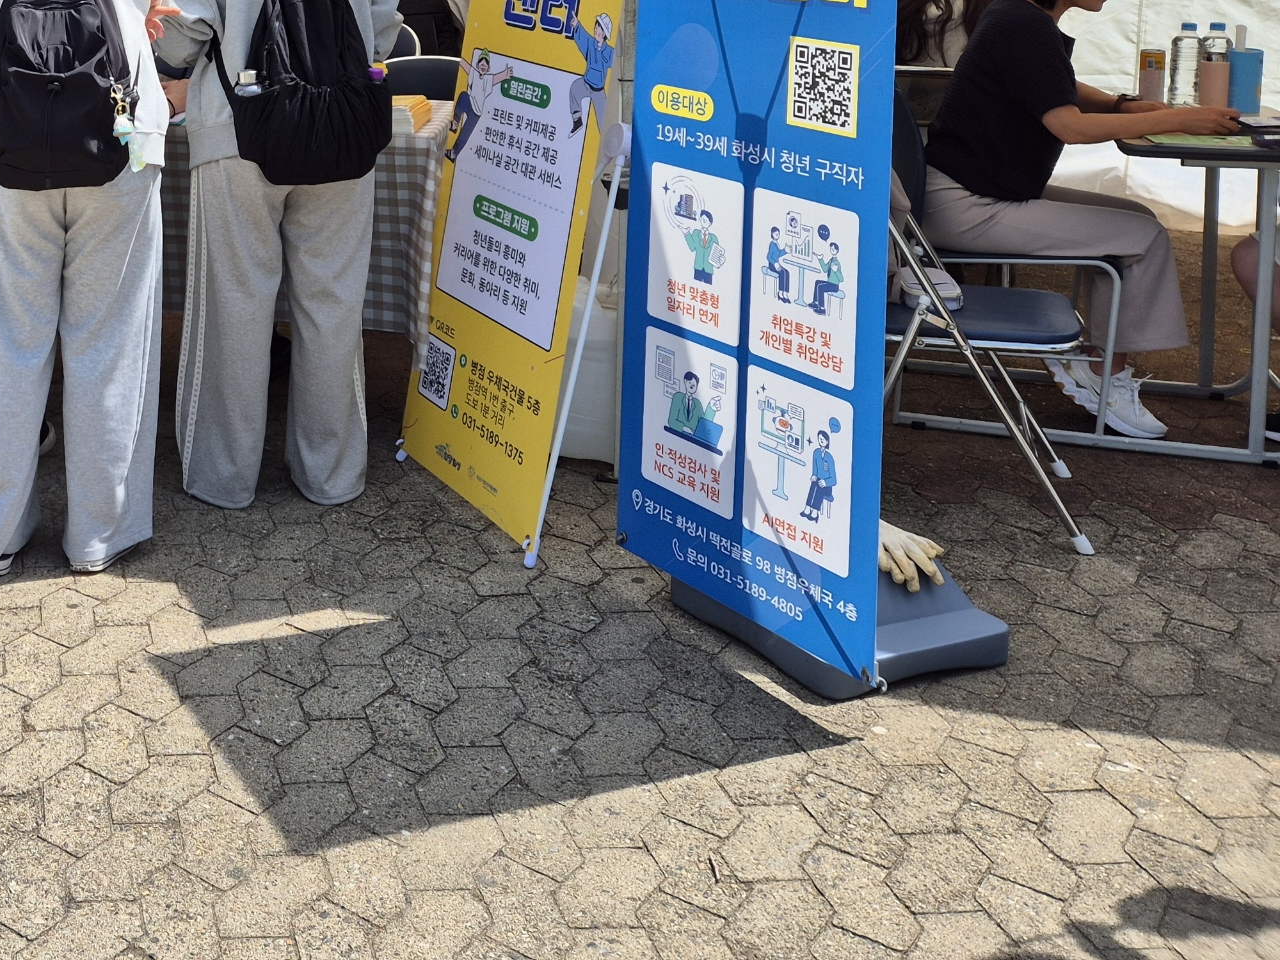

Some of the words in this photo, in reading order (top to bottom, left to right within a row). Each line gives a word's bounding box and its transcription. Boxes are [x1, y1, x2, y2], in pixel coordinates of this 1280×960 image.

[509, 80, 542, 103] 열린공간
[657, 89, 708, 116] 이용대상
[491, 107, 514, 126] 프린트
[515, 114, 524, 131] 및
[525, 118, 557, 141] 커피제공
[484, 126, 506, 146] 편안한
[508, 135, 523, 153] 휴식
[524, 140, 540, 159] 공간
[541, 146, 558, 165] 제공
[656, 124, 728, 158] 19세~39세
[731, 139, 776, 168] 화성시
[779, 149, 811, 177] 청년
[815, 158, 865, 190] 구직자
[474, 145, 503, 168] 세미나실
[504, 155, 520, 174] 공간
[521, 162, 537, 180] 대관
[538, 169, 562, 189] 서비스
[481, 201, 512, 227] 프로그램
[512, 214, 530, 235] 지원
[473, 229, 501, 256] 청년들의
[503, 244, 526, 268] 흥미와
[453, 242, 481, 268] 커리어를
[482, 256, 497, 276] 위한
[498, 265, 521, 289] 다양한
[523, 277, 540, 300] 취미,
[460, 267, 476, 289] 문화,
[478, 276, 501, 301] 동아리
[502, 289, 510, 306] 등
[511, 294, 528, 316] 지원
[666, 278, 687, 298] 청년
[689, 285, 720, 310] 맞춤형
[666, 295, 696, 319] 일자리
[698, 307, 720, 328] 연계
[435, 319, 456, 337] QR코드
[771, 313, 817, 343] 취업특강
[820, 330, 832, 349] 및
[759, 329, 793, 355] 개인별
[796, 342, 844, 374] 취업상담
[468, 377, 488, 398] 병점역
[488, 390, 500, 405] 1번
[500, 395, 516, 420] 출구,
[471, 359, 486, 381] 병점
[487, 370, 526, 406] 우체국건물
[527, 396, 541, 416] 5층
[464, 393, 479, 412] 도보
[480, 402, 490, 419] 1분
[491, 409, 506, 430] 거리
[461, 412, 525, 466] 031-5189-1375
[654, 460, 674, 479] NCS
[676, 472, 697, 492] 교육
[699, 482, 720, 503] 지원
[710, 467, 721, 486] 및
[762, 512, 797, 542] AI면접
[800, 525, 824, 555] 지원
[644, 497, 674, 525] 경기도
[676, 514, 707, 543] 화성시
[709, 526, 753, 566] 떡전골로
[755, 556, 771, 574] 98
[774, 564, 834, 609] 병점우체국
[836, 599, 859, 622] 4층
[686, 547, 708, 573] 문의
[711, 560, 804, 621] 031-5189-4805
